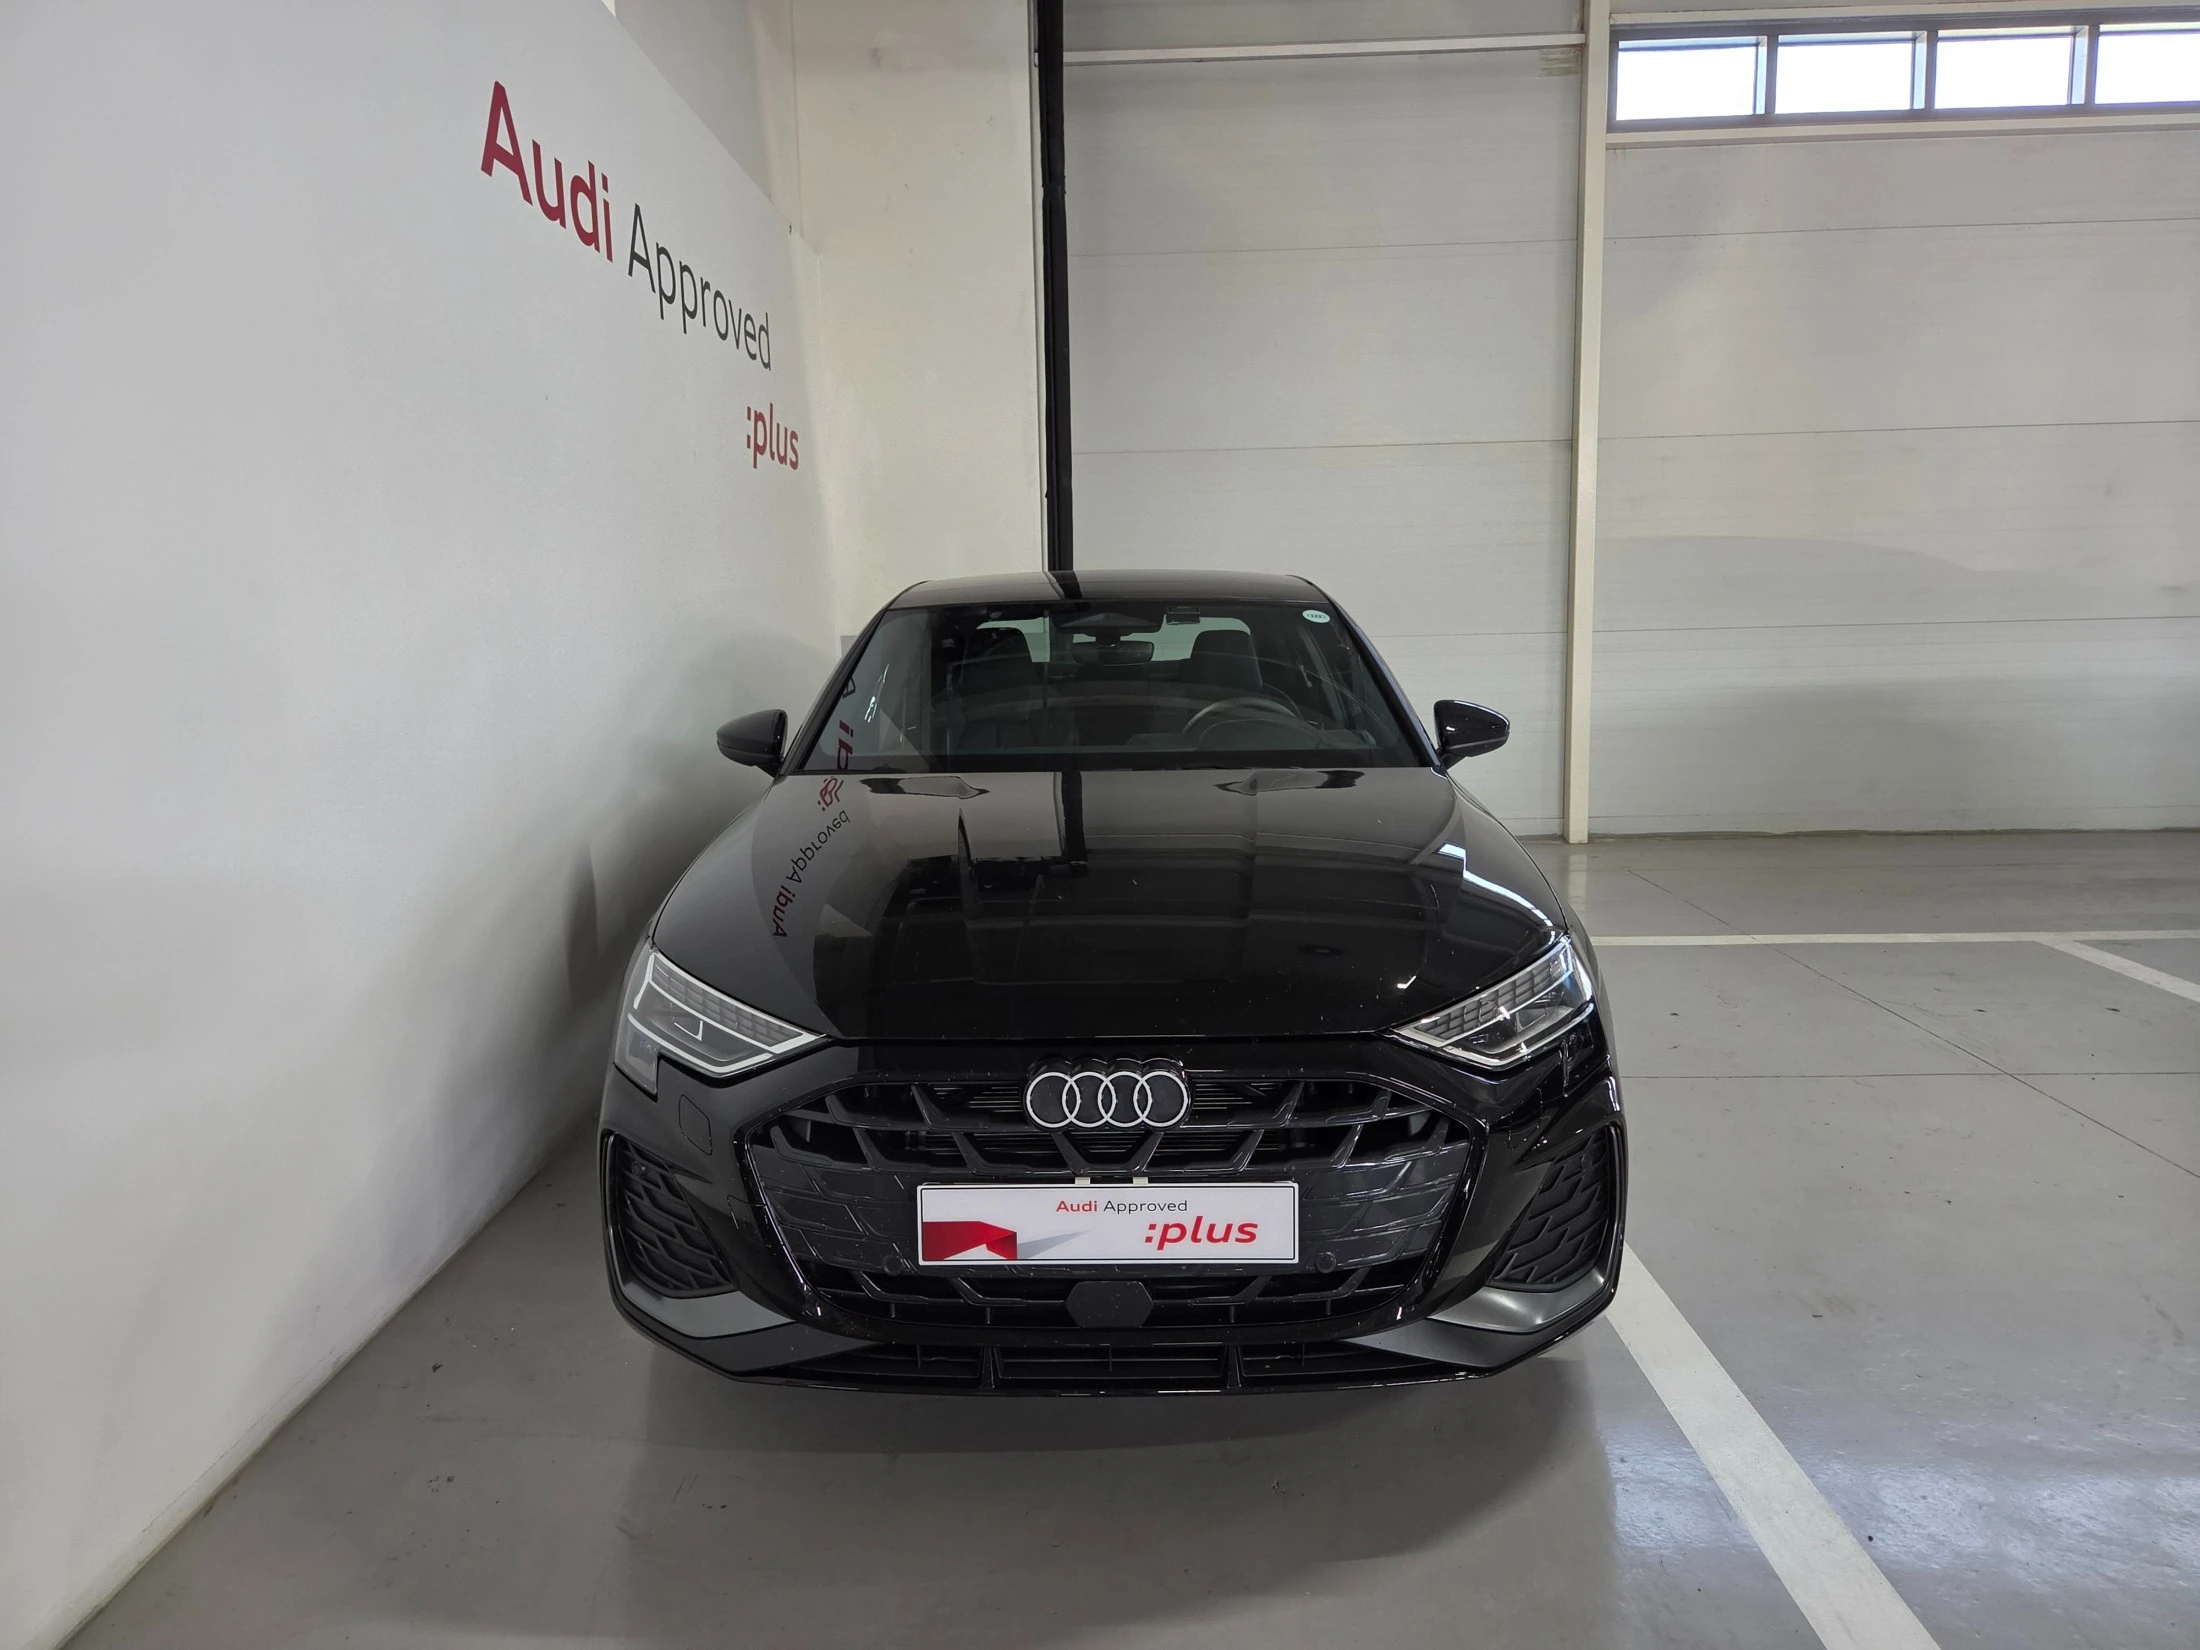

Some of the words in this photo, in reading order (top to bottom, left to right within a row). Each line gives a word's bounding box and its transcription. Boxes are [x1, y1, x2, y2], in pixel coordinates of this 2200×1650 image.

[480, 80, 613, 262] Audi
[628, 203, 772, 371] Approved
[746, 402, 799, 470] :plus
[1056, 1200, 1098, 1213] Audi
[1103, 1200, 1188, 1214] Approved
[1144, 1216, 1258, 1250] :plus
